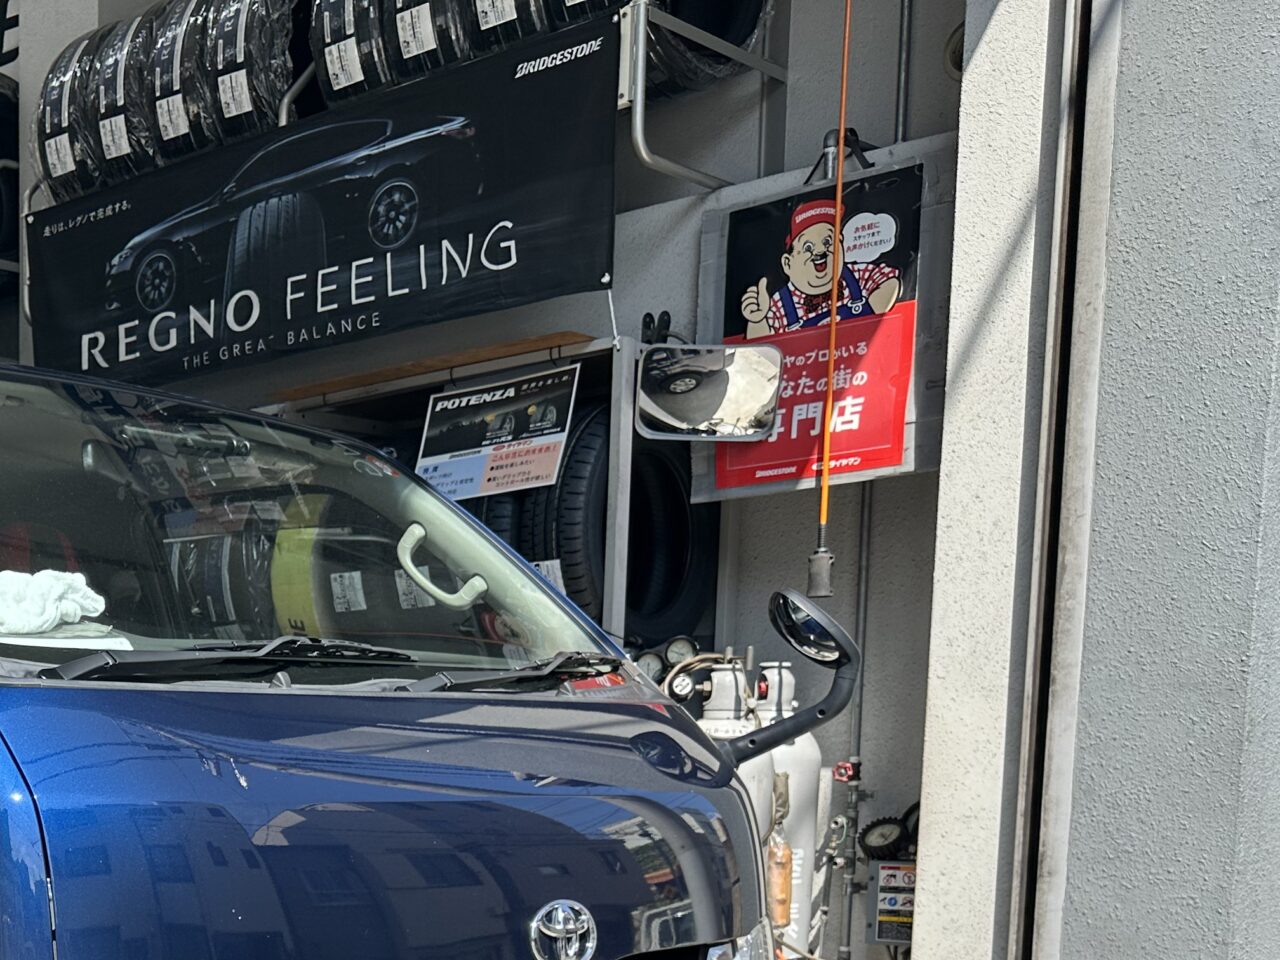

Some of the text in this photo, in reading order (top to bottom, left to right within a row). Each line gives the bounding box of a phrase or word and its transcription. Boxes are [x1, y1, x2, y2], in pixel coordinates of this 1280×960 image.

[514, 36, 604, 79] BRIDGESTONE
[81, 220, 518, 370] REGNO FEELING
[182, 312, 381, 370] THE GREA BALANCE
[435, 386, 516, 412] POTENZA
